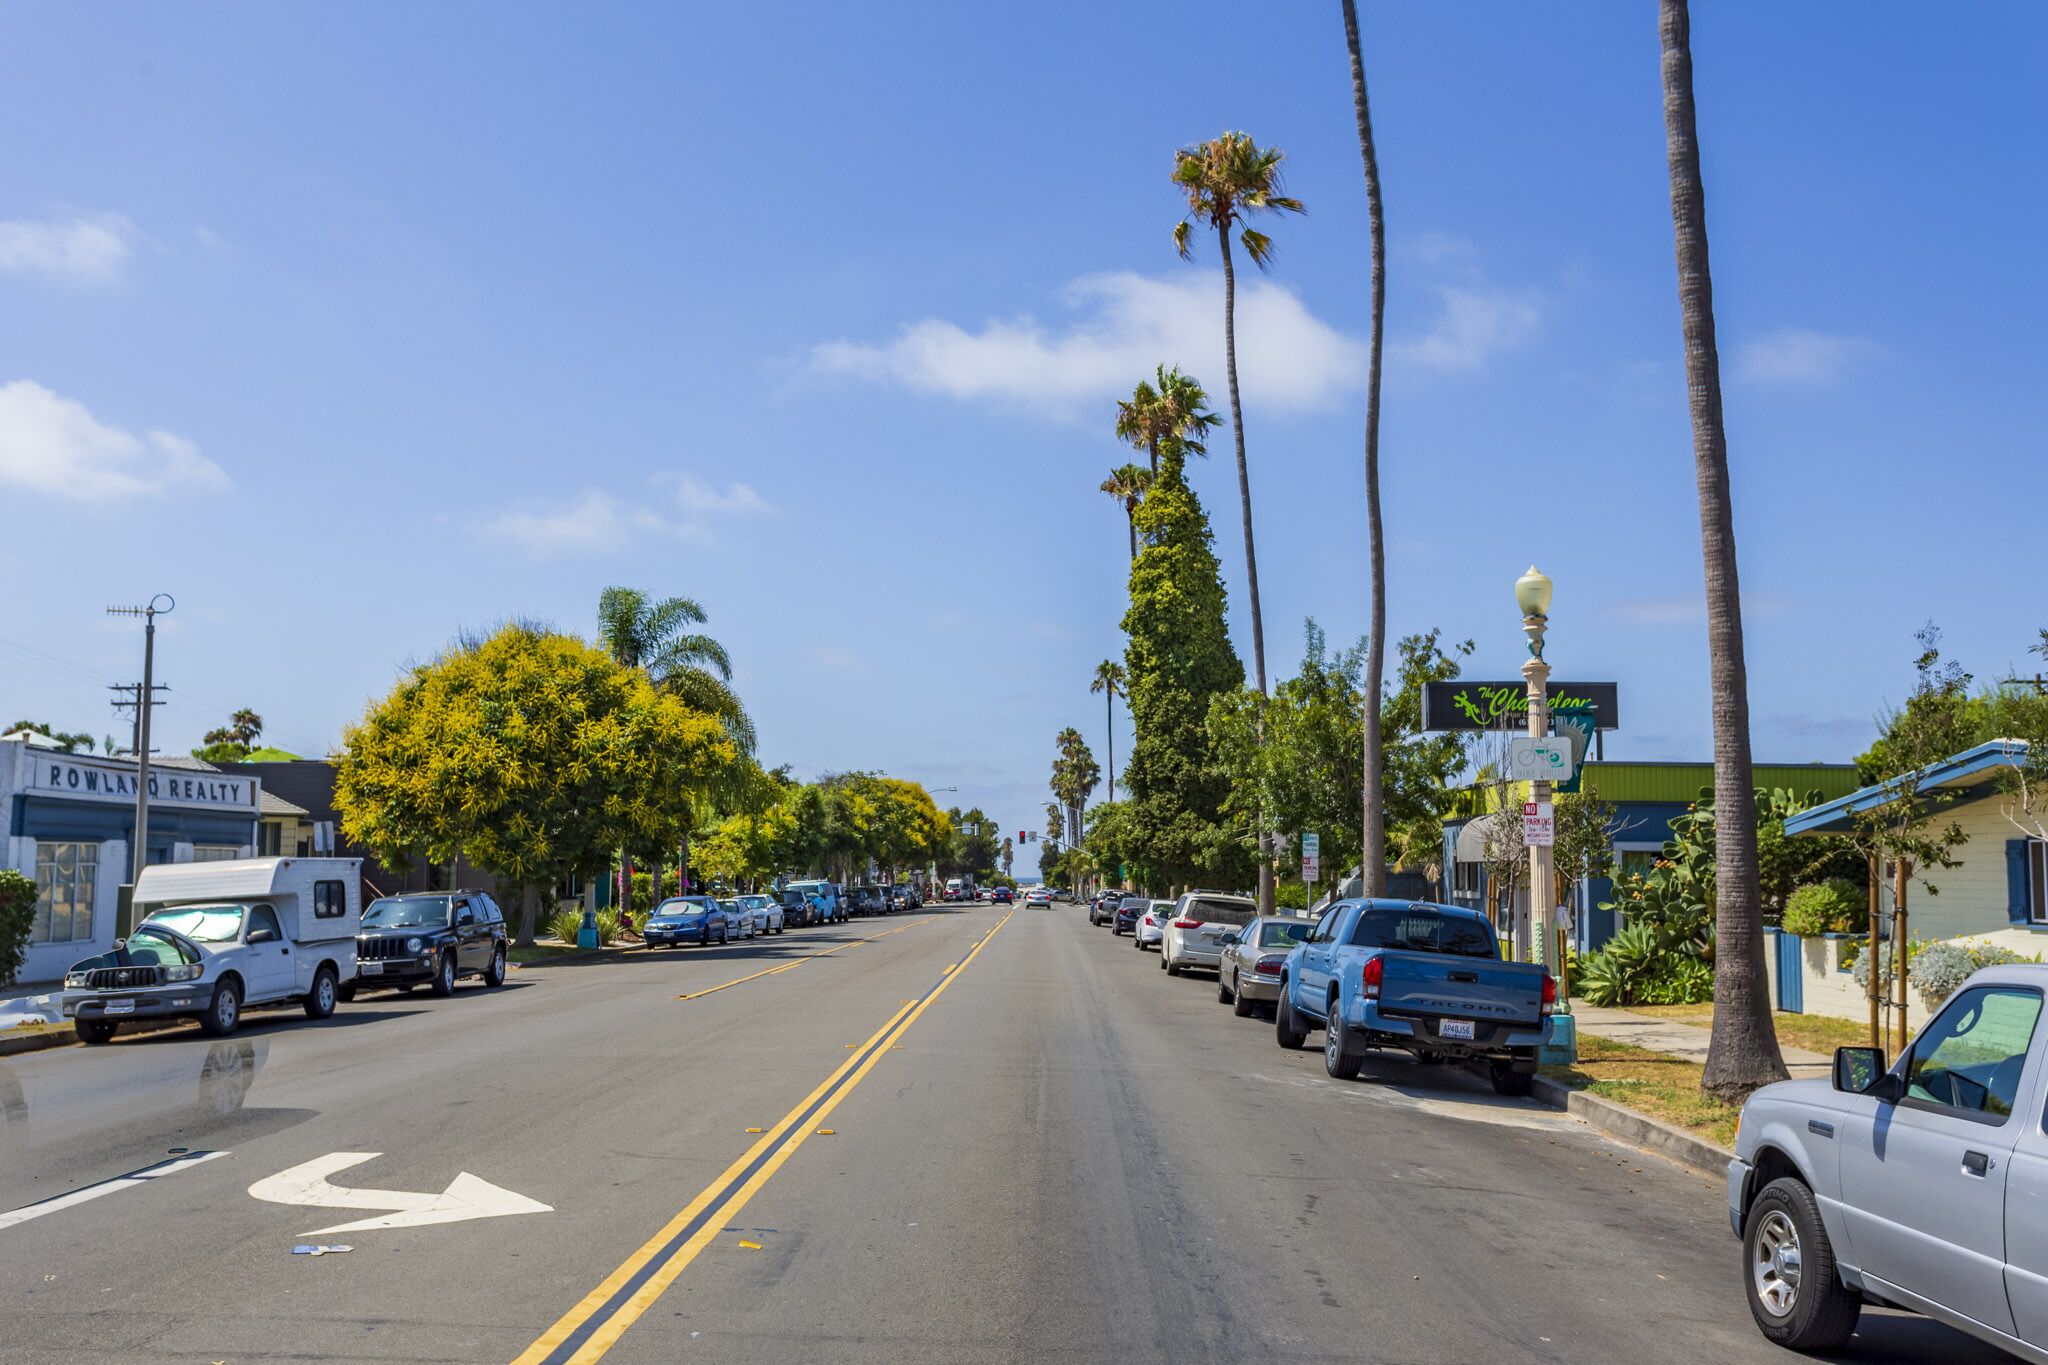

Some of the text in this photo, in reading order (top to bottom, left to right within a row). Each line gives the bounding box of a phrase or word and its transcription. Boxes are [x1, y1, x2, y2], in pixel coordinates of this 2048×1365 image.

[1478, 687, 1591, 716] The Chaeleon
[170, 779, 239, 802] REALTY
[1525, 804, 1536, 815] NO
[1526, 817, 1552, 826] PARKING
[1419, 1000, 1507, 1013] TACOMA
